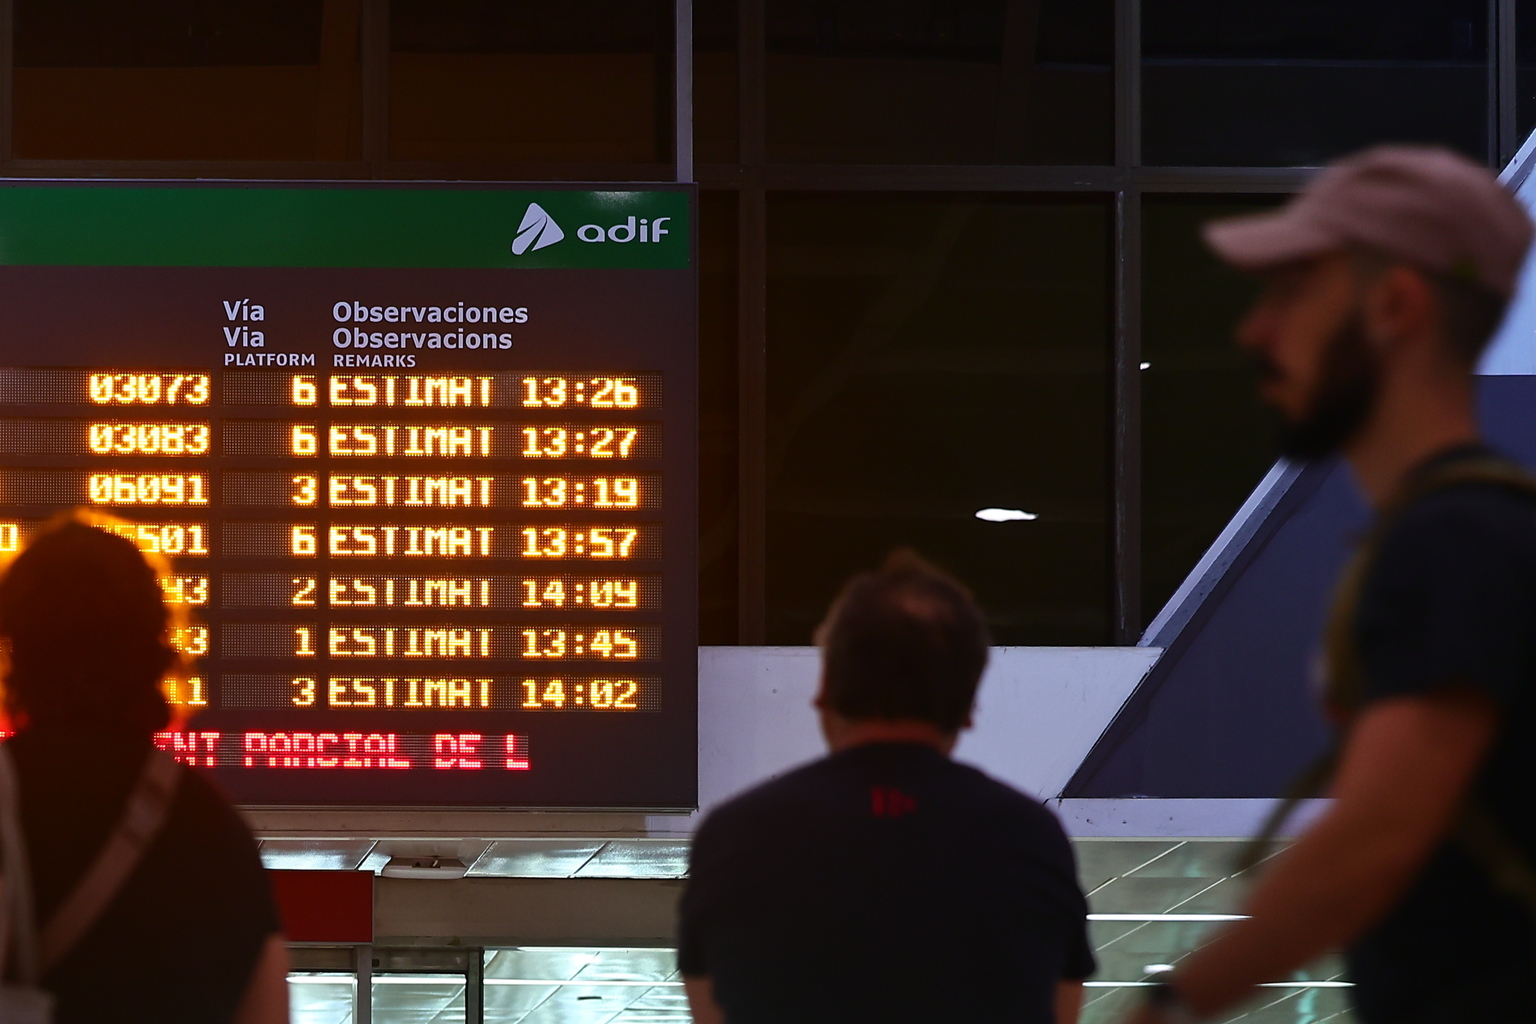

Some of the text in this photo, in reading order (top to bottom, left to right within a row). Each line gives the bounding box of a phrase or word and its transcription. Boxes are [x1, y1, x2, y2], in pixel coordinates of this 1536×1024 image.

[576, 215, 671, 243] adif
[223, 298, 264, 322] Vía
[332, 300, 528, 324] Observaciones
[223, 326, 264, 348] Via
[332, 327, 513, 350] Observacions
[224, 353, 315, 366] PLATFORM
[333, 354, 416, 368] REMARKS
[88, 373, 210, 405] 03073
[291, 374, 317, 406] 6
[329, 375, 494, 407] ESTIMAT
[522, 376, 638, 409] 13:26
[88, 423, 210, 455] 03083
[291, 425, 317, 456] 6
[329, 425, 495, 458] ESTIMAT
[522, 427, 638, 459] 13:27
[88, 473, 209, 506] 06091
[292, 475, 317, 506] 3
[328, 475, 495, 508] ESTIMAT
[522, 477, 639, 509] 13:19
[290, 525, 317, 556] 6
[329, 526, 495, 556] ESTIMAT
[522, 527, 638, 558] 13:57
[292, 576, 316, 605] 2
[329, 577, 494, 606] ESTIMAT
[522, 578, 637, 607] 14:09
[295, 627, 315, 656] 1
[329, 627, 494, 657] ESTIMAT
[522, 628, 637, 658] 13:45
[292, 677, 315, 706] 3
[328, 677, 494, 707] ESTIMAT
[522, 679, 637, 708] 14:02
[435, 733, 482, 768] DE
[505, 734, 530, 769] L
